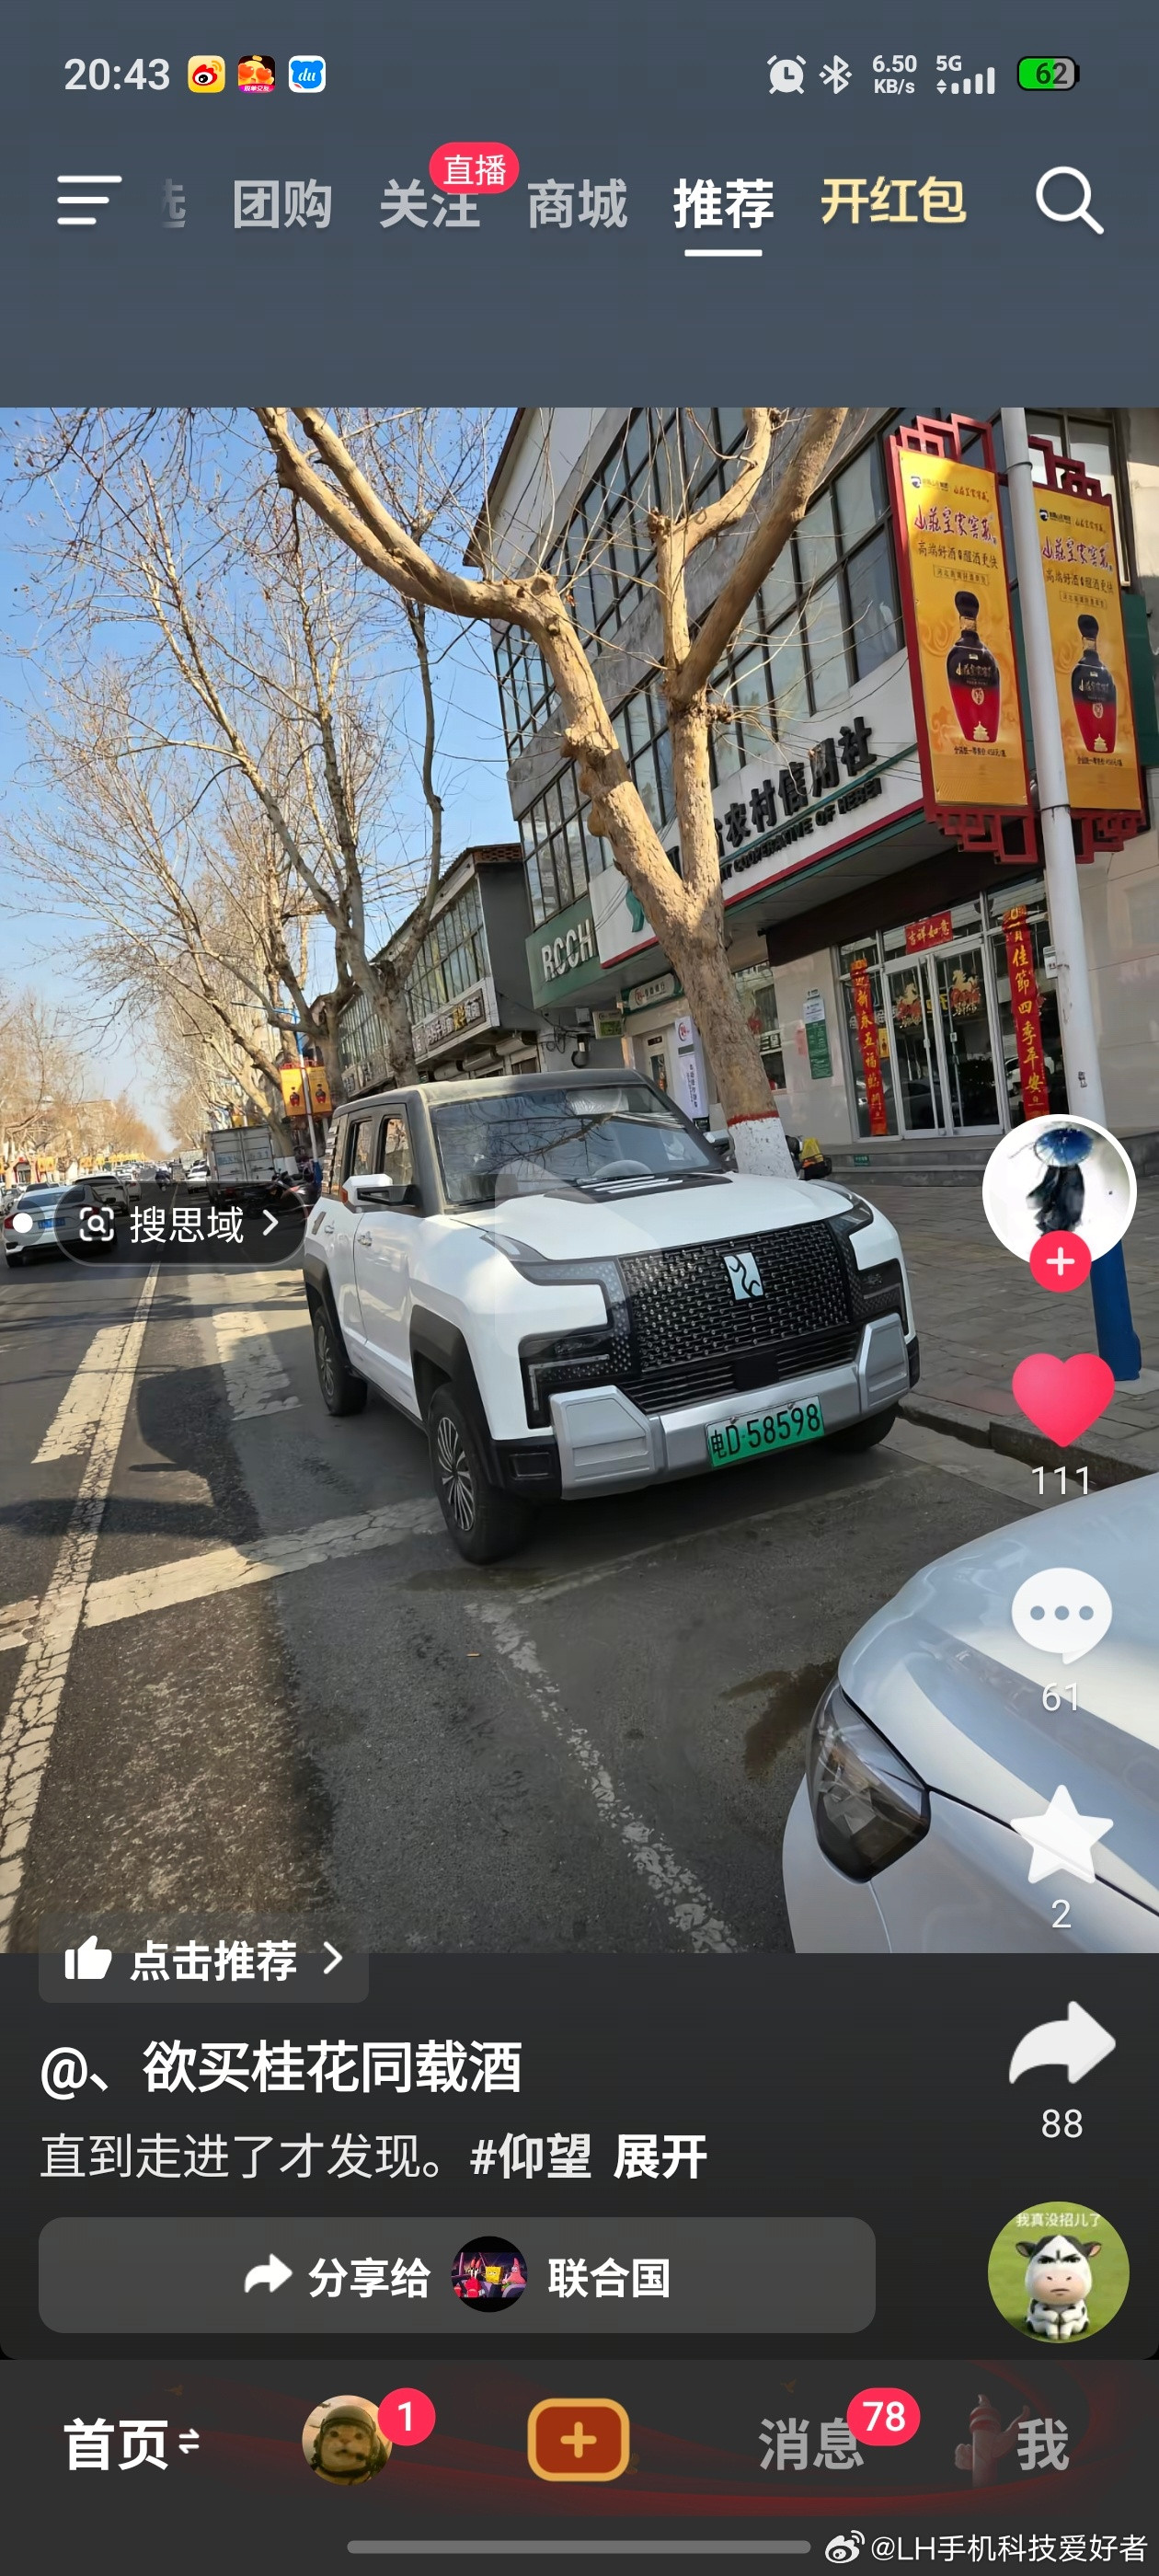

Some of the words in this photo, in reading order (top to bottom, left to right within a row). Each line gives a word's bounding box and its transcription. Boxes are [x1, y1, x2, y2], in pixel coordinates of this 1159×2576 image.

[815, 804, 836, 826] OF
[541, 918, 593, 982] RCCH
[908, 919, 950, 947] 吉祥如意
[1010, 907, 1045, 1094] 佳節四季平安
